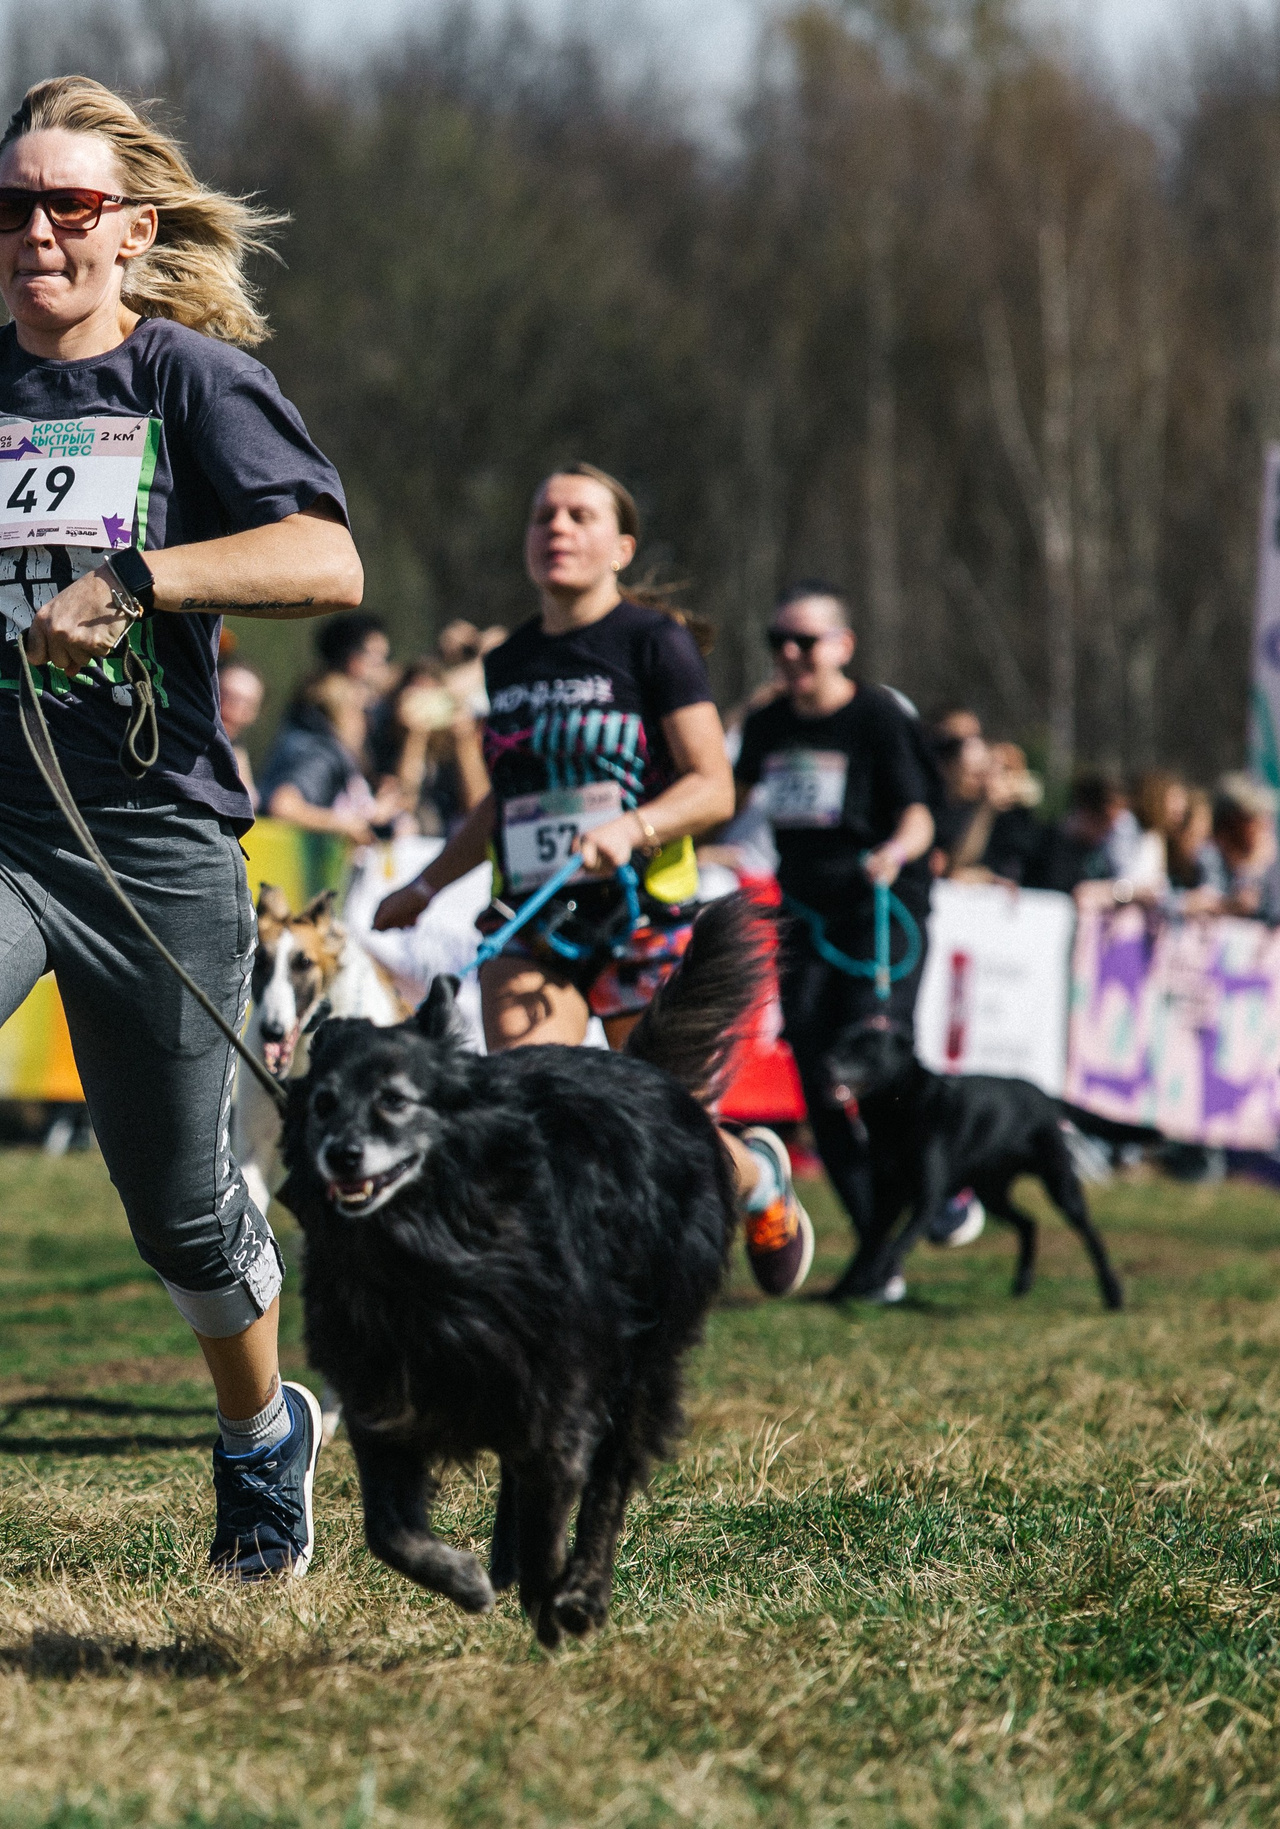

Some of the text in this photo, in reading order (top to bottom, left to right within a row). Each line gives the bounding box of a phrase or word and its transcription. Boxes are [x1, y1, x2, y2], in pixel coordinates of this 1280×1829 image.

[32, 421, 84, 435] КРОСС
[100, 431, 110, 441] 2
[6, 465, 76, 514] 49
[536, 823, 579, 863] 57
